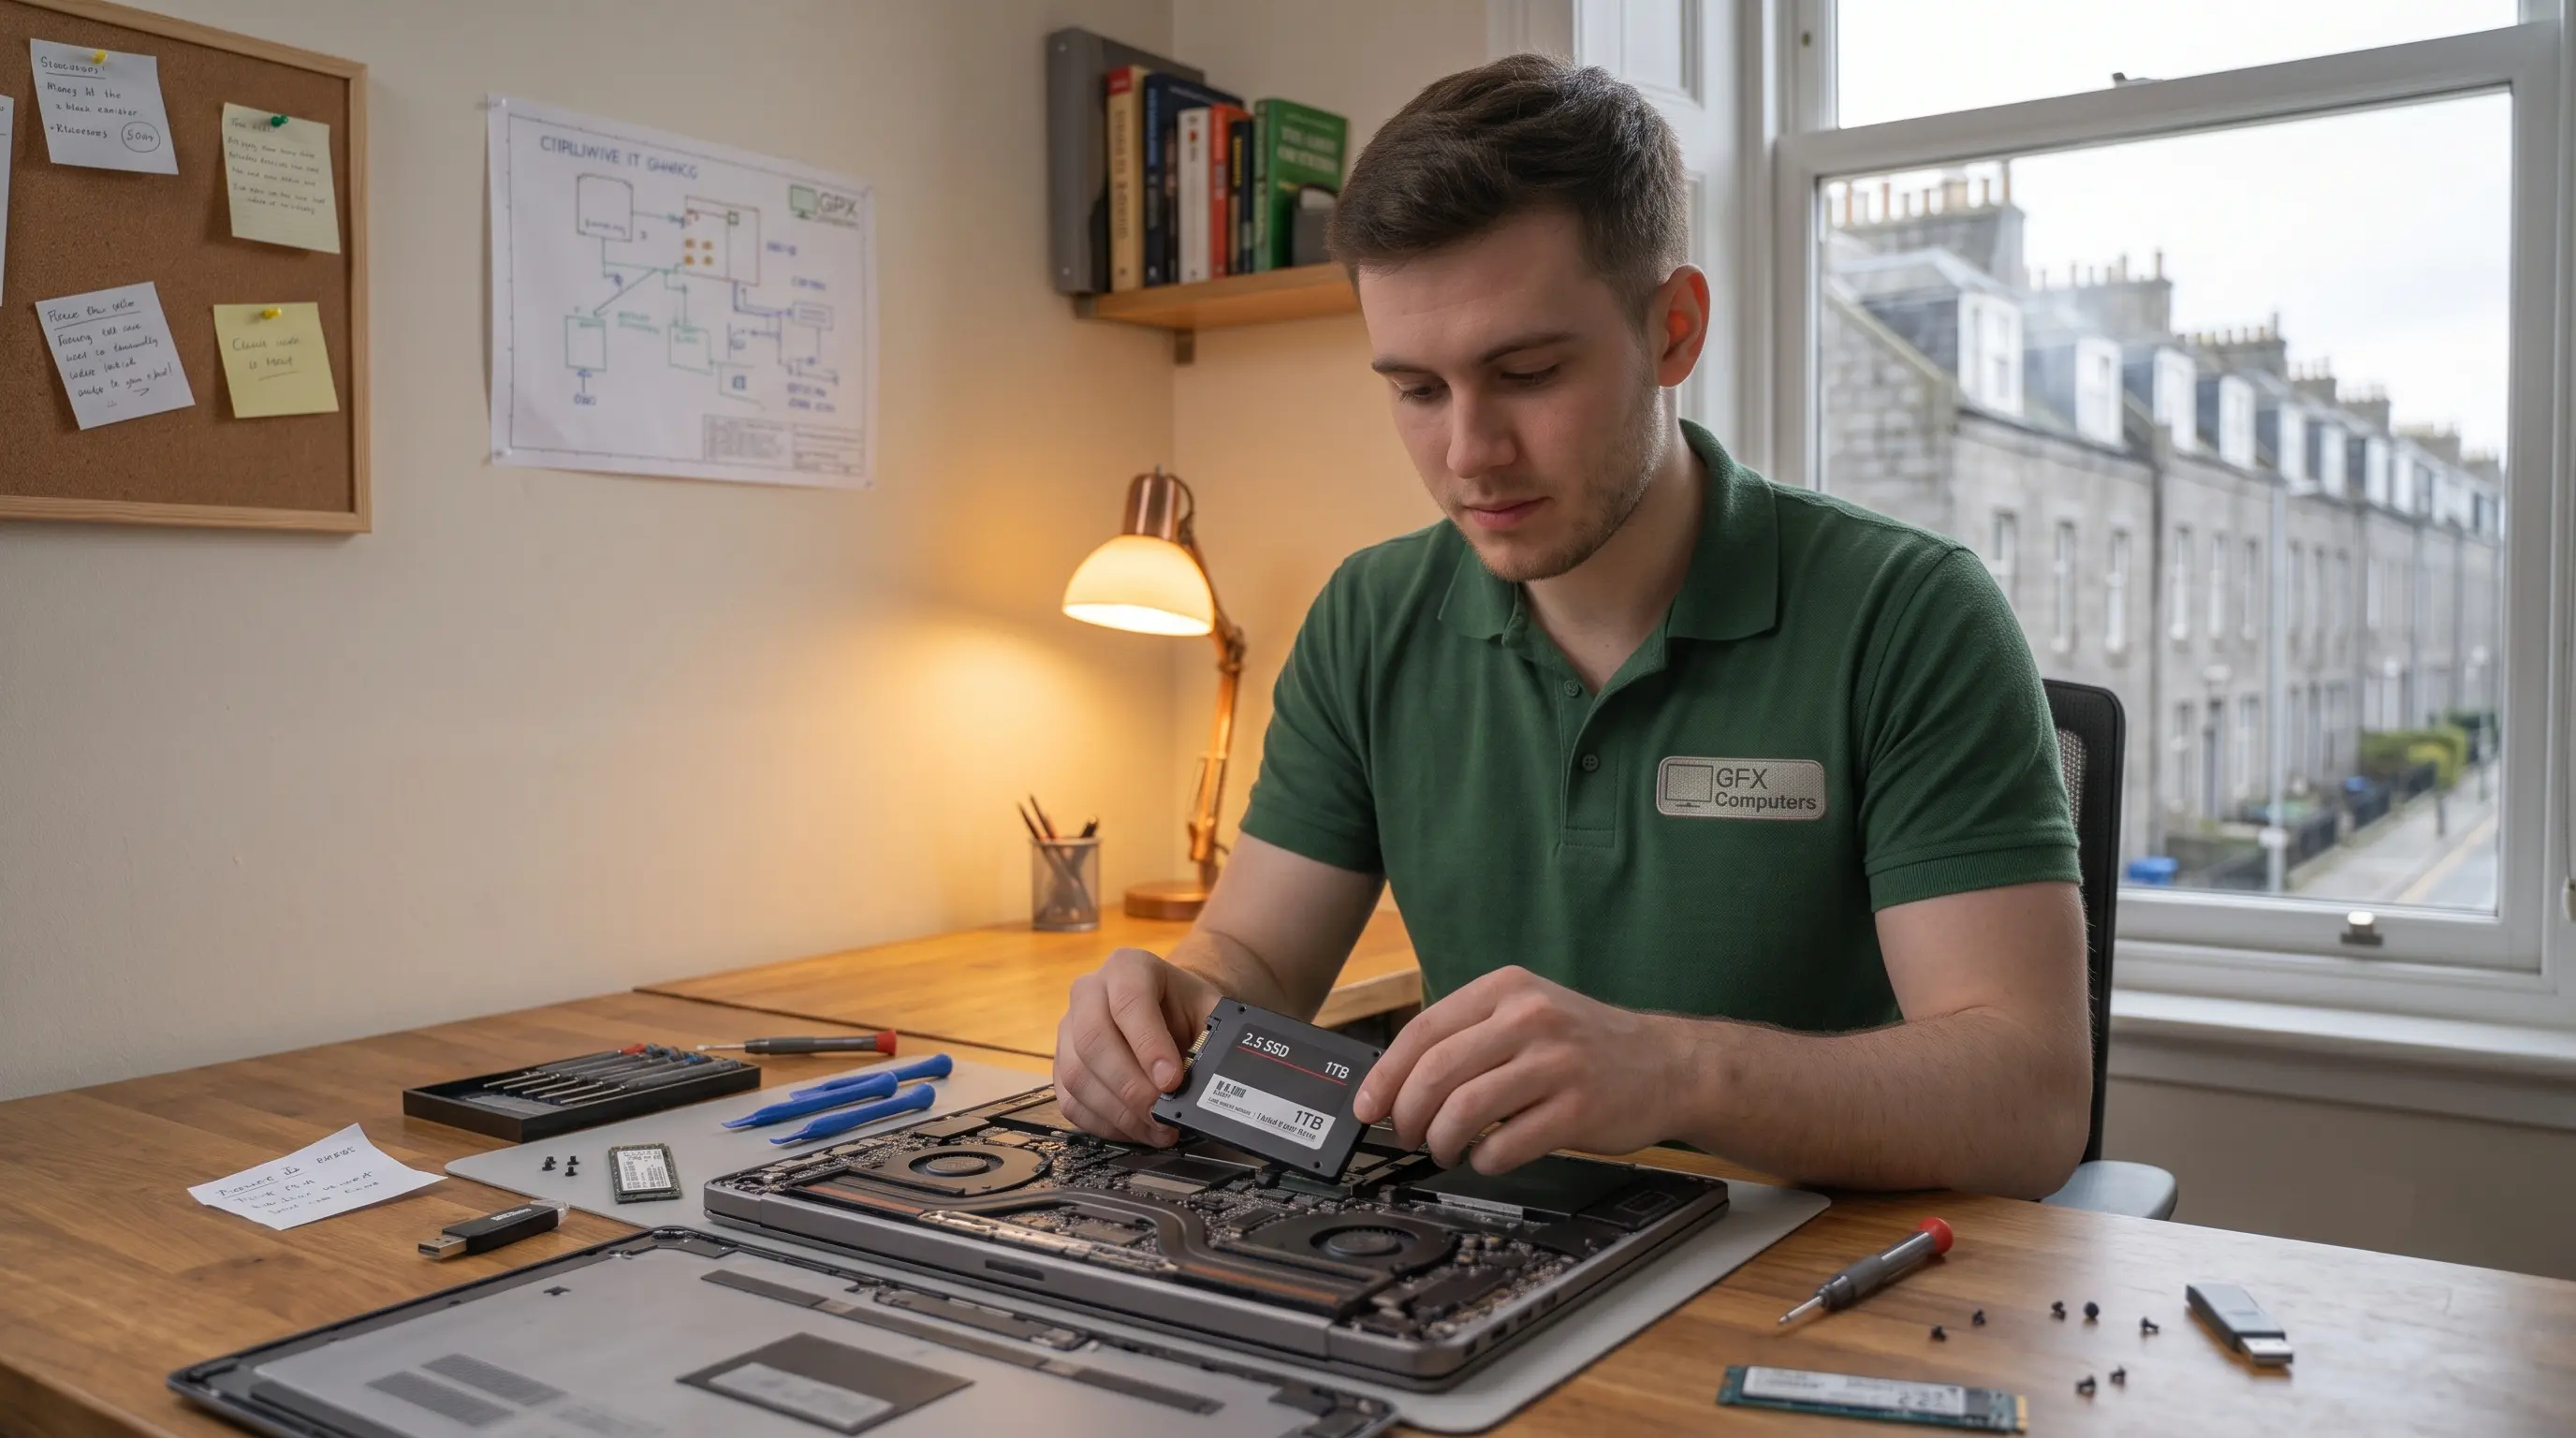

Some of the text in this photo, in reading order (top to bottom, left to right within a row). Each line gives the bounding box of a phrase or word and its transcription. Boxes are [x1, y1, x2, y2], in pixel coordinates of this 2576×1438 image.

[627, 153, 641, 167] IT
[1716, 768, 1768, 789] GFX
[1715, 791, 1817, 813] Computers
[1241, 1033, 1290, 1058] 2.5 SSD
[1325, 1062, 1350, 1079] 1TB
[1294, 1109, 1325, 1131] 1TB
